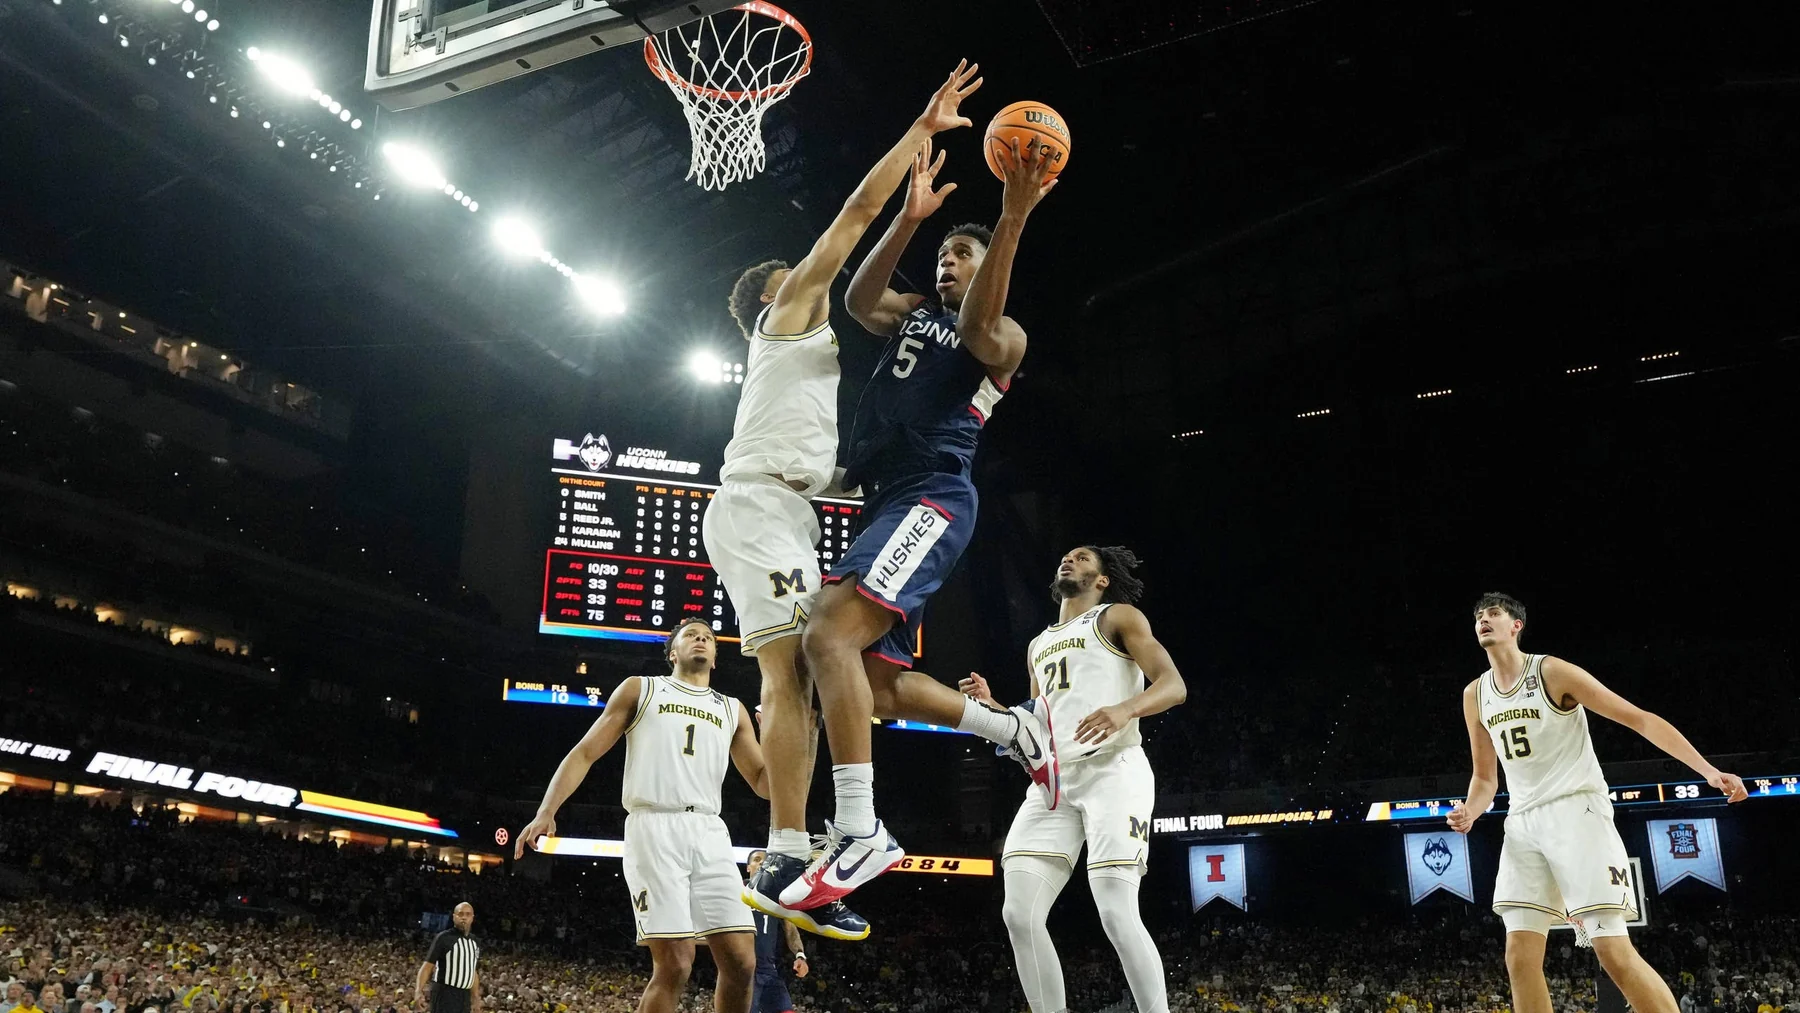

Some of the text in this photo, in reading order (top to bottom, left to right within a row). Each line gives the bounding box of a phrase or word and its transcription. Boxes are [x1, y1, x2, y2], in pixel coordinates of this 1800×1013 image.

[892, 336, 925, 379] 5
[626, 446, 667, 459] UCONN
[615, 454, 701, 475] HUSKIES
[570, 478, 583, 486] THE
[583, 479, 606, 488] COURT
[635, 485, 650, 493] PTS
[561, 488, 699, 511] 0 SMITH 4 3 3 0
[822, 505, 836, 513] PTS
[573, 501, 599, 512] BALL
[655, 510, 663, 519] 0
[672, 512, 681, 521] 0
[690, 513, 699, 523] 0
[824, 515, 849, 526] 0 5
[559, 512, 567, 521] 5
[573, 513, 600, 524] REED
[600, 516, 615, 526] JR.
[636, 520, 644, 529] 4
[672, 523, 680, 533] 0
[689, 525, 698, 534] 0
[824, 528, 849, 538] 4 2
[572, 526, 621, 539] KARABAN
[653, 534, 661, 543] 4
[689, 537, 697, 546] 0
[554, 536, 697, 558] 24 MULLINS 3 3 0 0
[823, 550, 833, 560] 10
[876, 510, 935, 590] HUSKIES
[588, 562, 619, 576] 10/30
[625, 567, 645, 576] AST
[654, 569, 665, 580] 4
[685, 573, 704, 581] BLK
[823, 563, 832, 572] 4
[588, 578, 607, 590] 33
[617, 582, 644, 591] OREB
[654, 584, 664, 595] 8
[690, 589, 703, 597] TO
[714, 589, 724, 601] 4
[769, 568, 807, 598] M
[587, 593, 606, 605] 33
[616, 597, 643, 606] DREB
[651, 599, 665, 611] 12
[713, 604, 723, 616] 3
[587, 609, 604, 621] 75
[624, 614, 642, 622] STL
[652, 615, 663, 626] 0
[712, 620, 722, 631] 8
[1035, 637, 1086, 667] MICHIGAN
[1044, 656, 1071, 697] 21
[515, 681, 601, 695] BONUS FLS TOL
[551, 692, 598, 706] 10 3
[658, 703, 723, 729] MICHIGAN
[1487, 708, 1541, 729] MICHIGAN
[683, 724, 696, 757] 1
[1500, 725, 1532, 760] 15
[86, 751, 195, 790] FINAL
[194, 771, 298, 807] FOUR
[1754, 777, 1798, 787] TOL FLS
[1759, 783, 1797, 795] 4 4
[1674, 785, 1700, 799] 33
[1395, 801, 1420, 810] BONUS
[1426, 800, 1440, 808] FLS
[1429, 807, 1439, 816] 10
[1129, 815, 1148, 842] M
[1153, 809, 1333, 834] FINAL FOUR INDIANAPOLIS, IN
[1671, 829, 1694, 839] FINAL
[1674, 844, 1696, 854] FOUR
[1608, 865, 1630, 888] M
[632, 887, 649, 913] M
